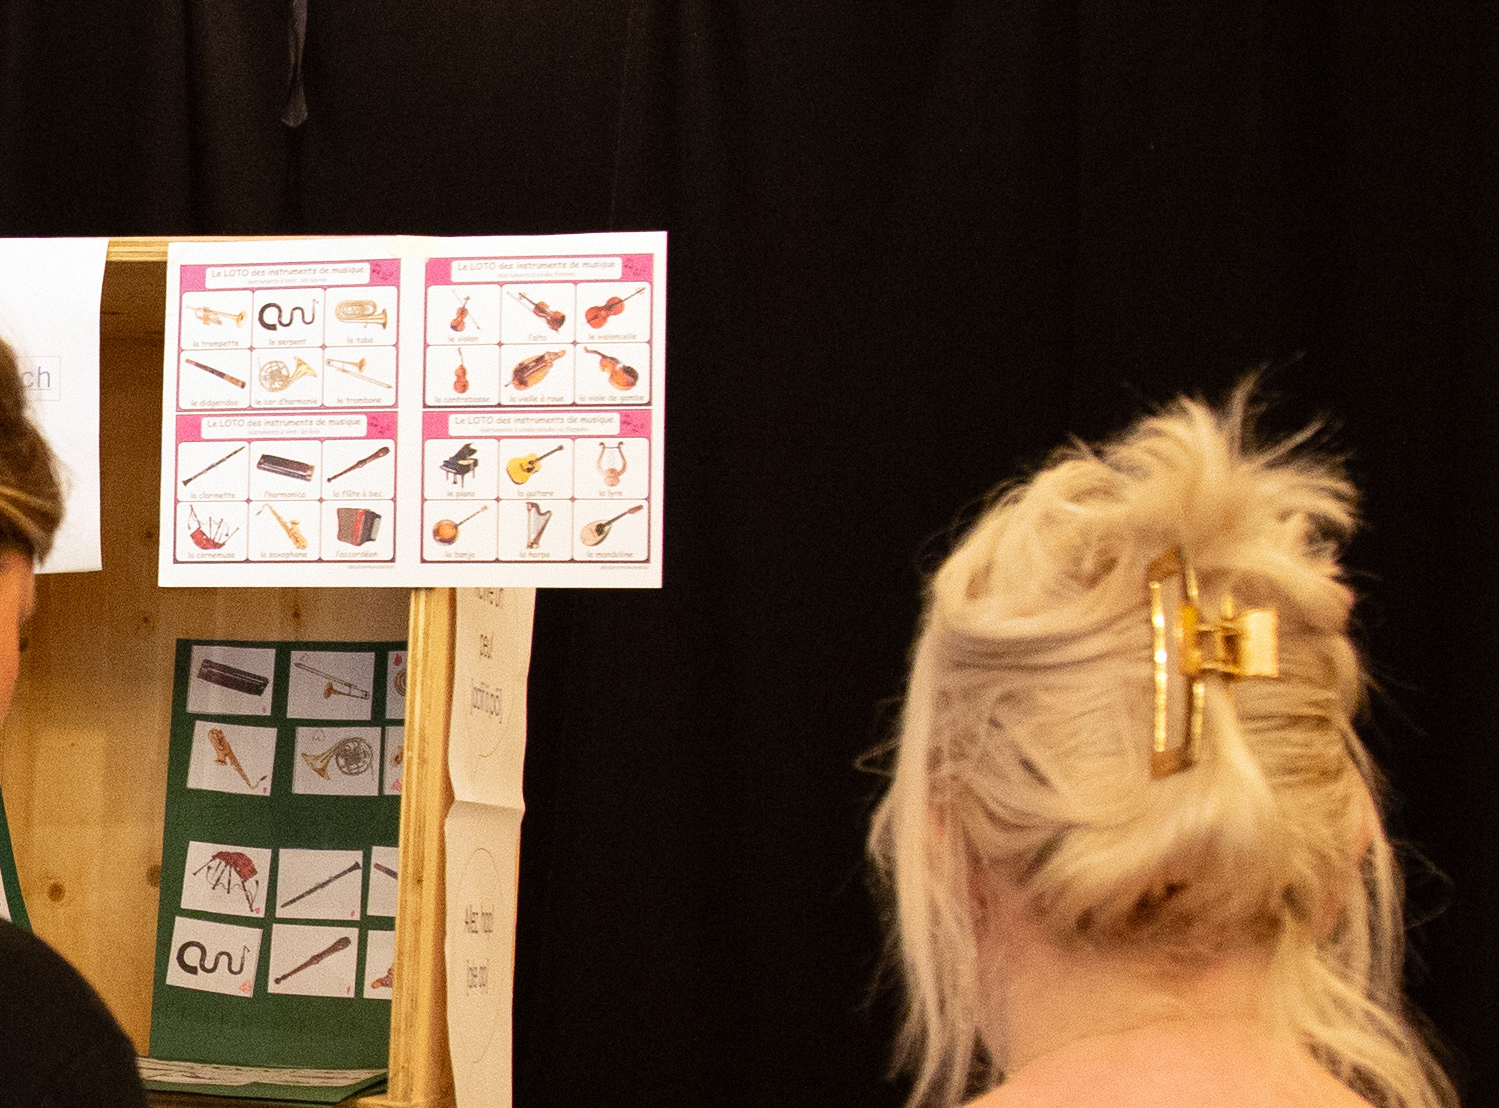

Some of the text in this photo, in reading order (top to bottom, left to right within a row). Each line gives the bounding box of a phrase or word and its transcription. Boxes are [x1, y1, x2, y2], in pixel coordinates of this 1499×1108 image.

[458, 260, 616, 271] Le LOTO des instruments de musique
[211, 266, 364, 278] Le LOTO des instruments de musique
[220, 419, 245, 427] LOTO
[247, 418, 262, 427] des
[264, 418, 313, 426] instruments
[316, 418, 326, 426] de
[329, 418, 361, 426] musique
[455, 416, 466, 424] Le
[468, 416, 494, 424] LOTO
[497, 416, 512, 424] des
[581, 416, 614, 425] musique
